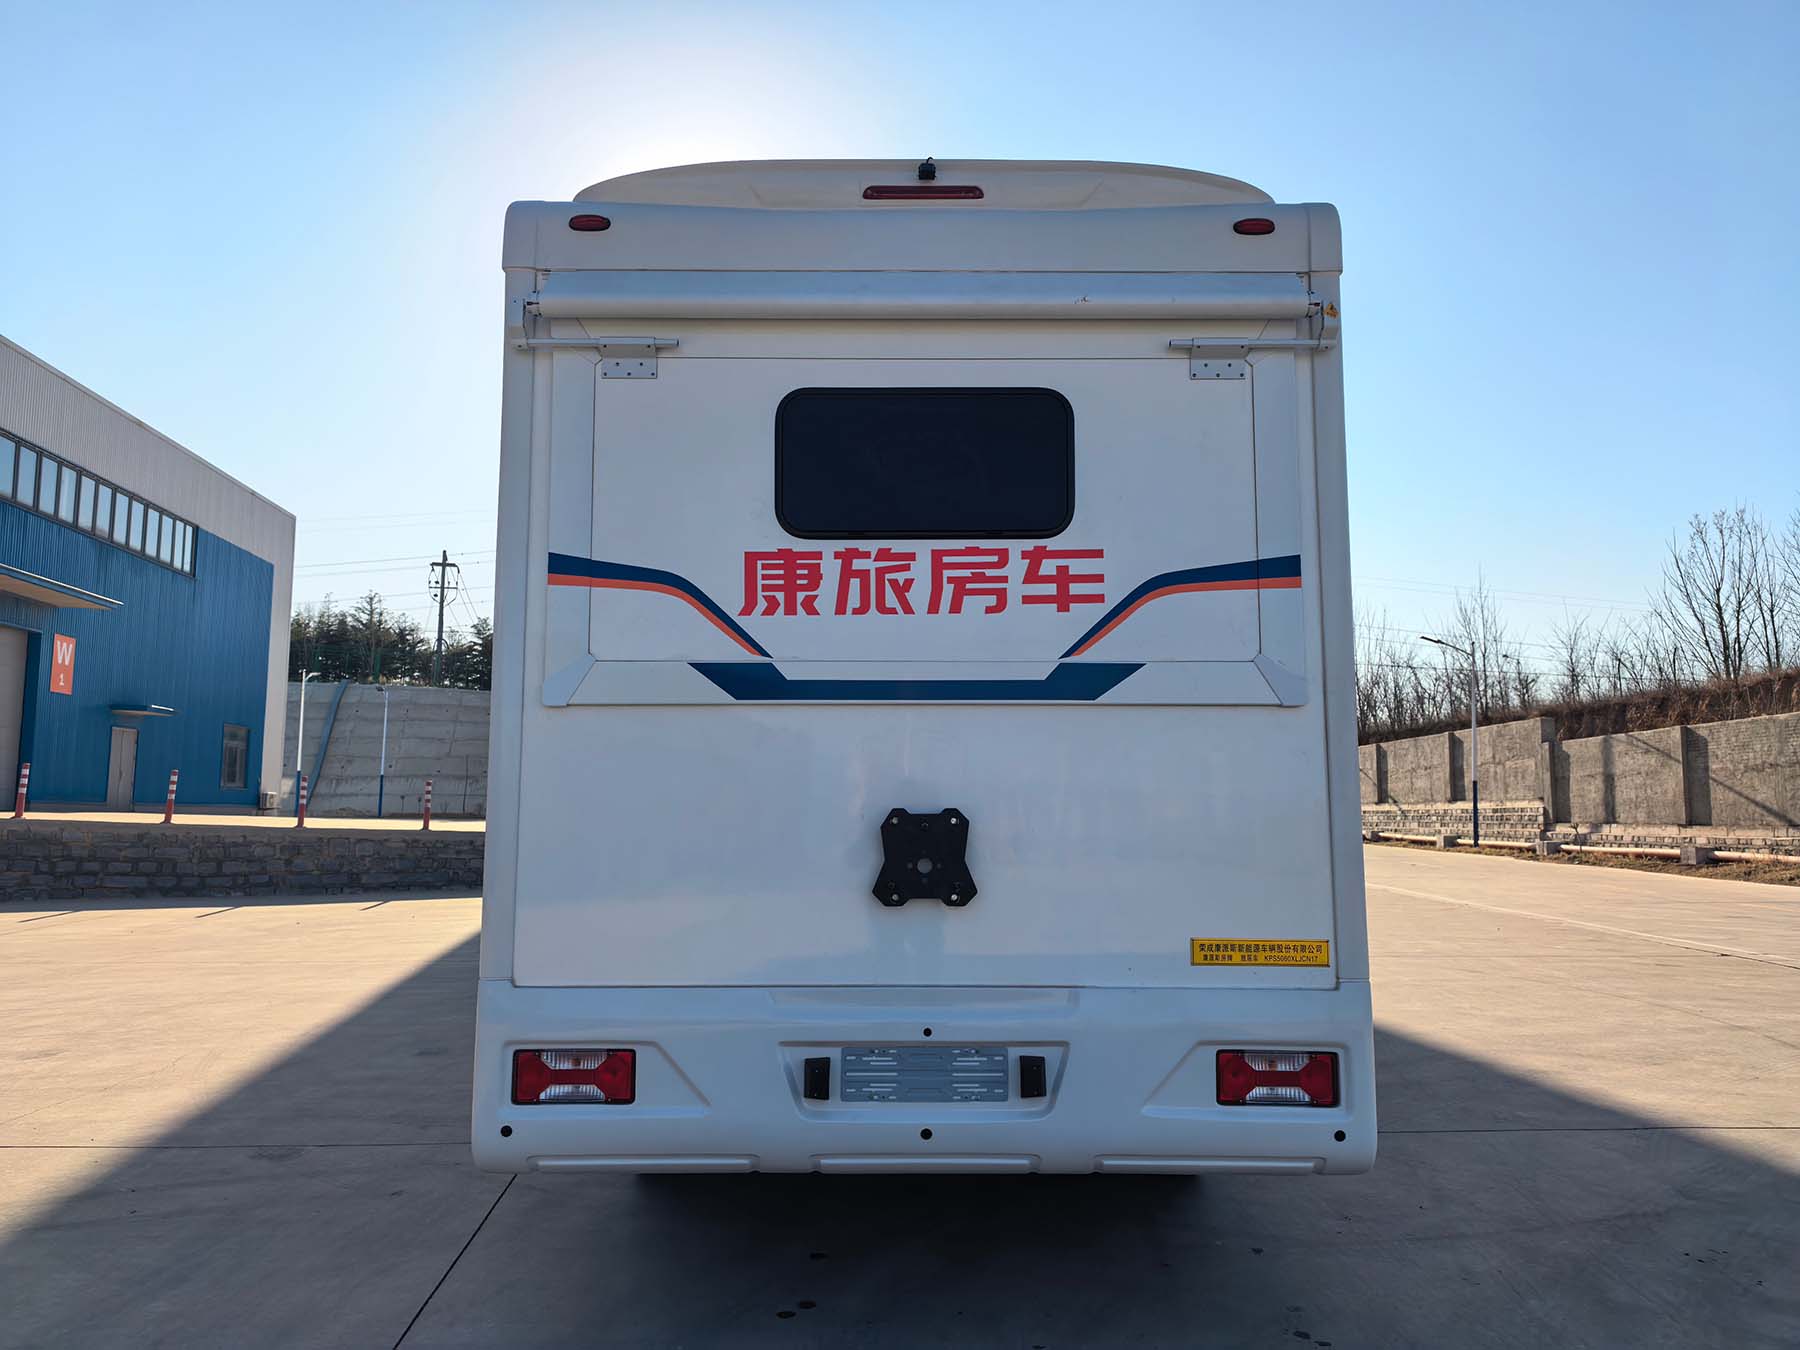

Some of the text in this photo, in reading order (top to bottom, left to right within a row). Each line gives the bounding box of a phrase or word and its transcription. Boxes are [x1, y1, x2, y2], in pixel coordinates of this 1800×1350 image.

[737, 545, 1105, 616] 康旅房车
[57, 640, 73, 666] W
[59, 673, 65, 686] 1
